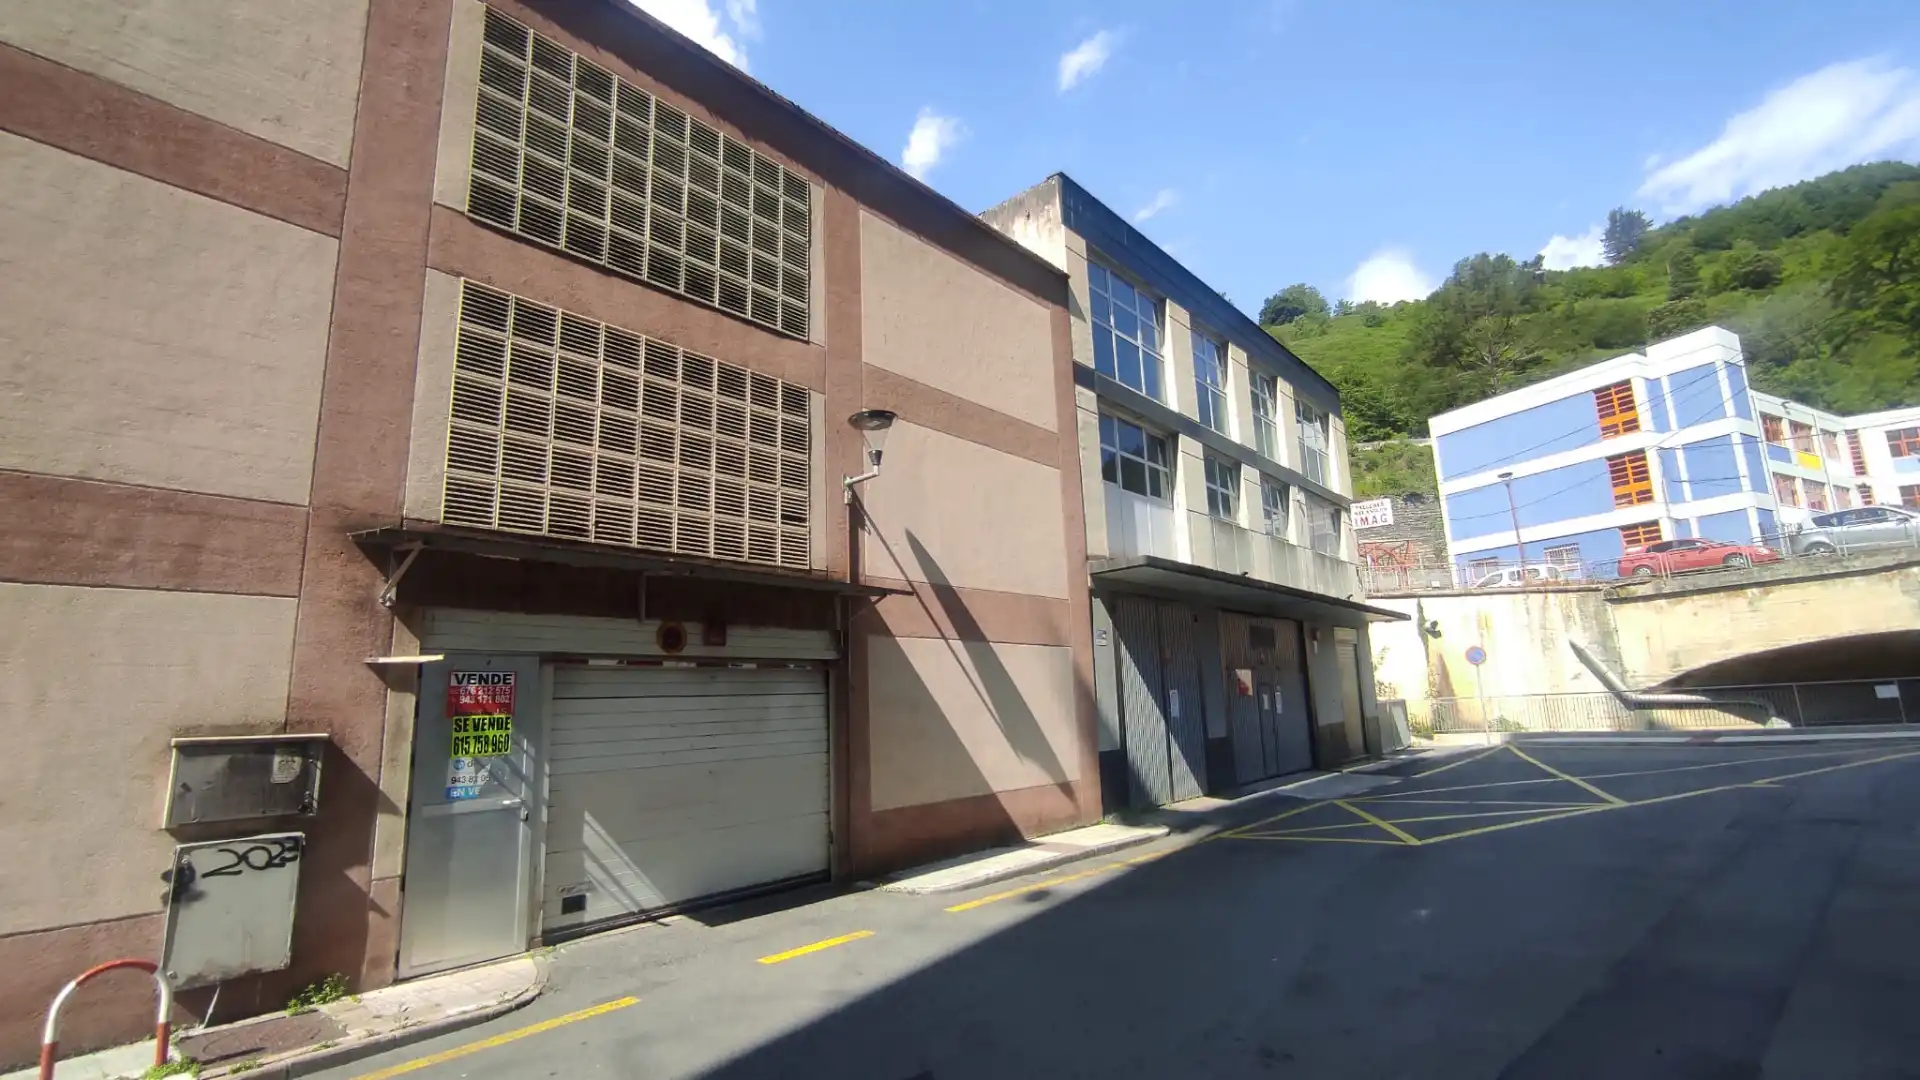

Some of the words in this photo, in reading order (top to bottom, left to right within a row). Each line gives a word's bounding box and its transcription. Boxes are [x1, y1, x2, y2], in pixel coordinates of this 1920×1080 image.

[454, 673, 513, 685] VENDE
[495, 686, 511, 695] 575
[459, 695, 476, 704] 943
[454, 717, 469, 733] SE
[472, 716, 511, 732] VENDE
[453, 735, 471, 756] 615
[472, 734, 489, 755] 758
[491, 733, 510, 753] 960
